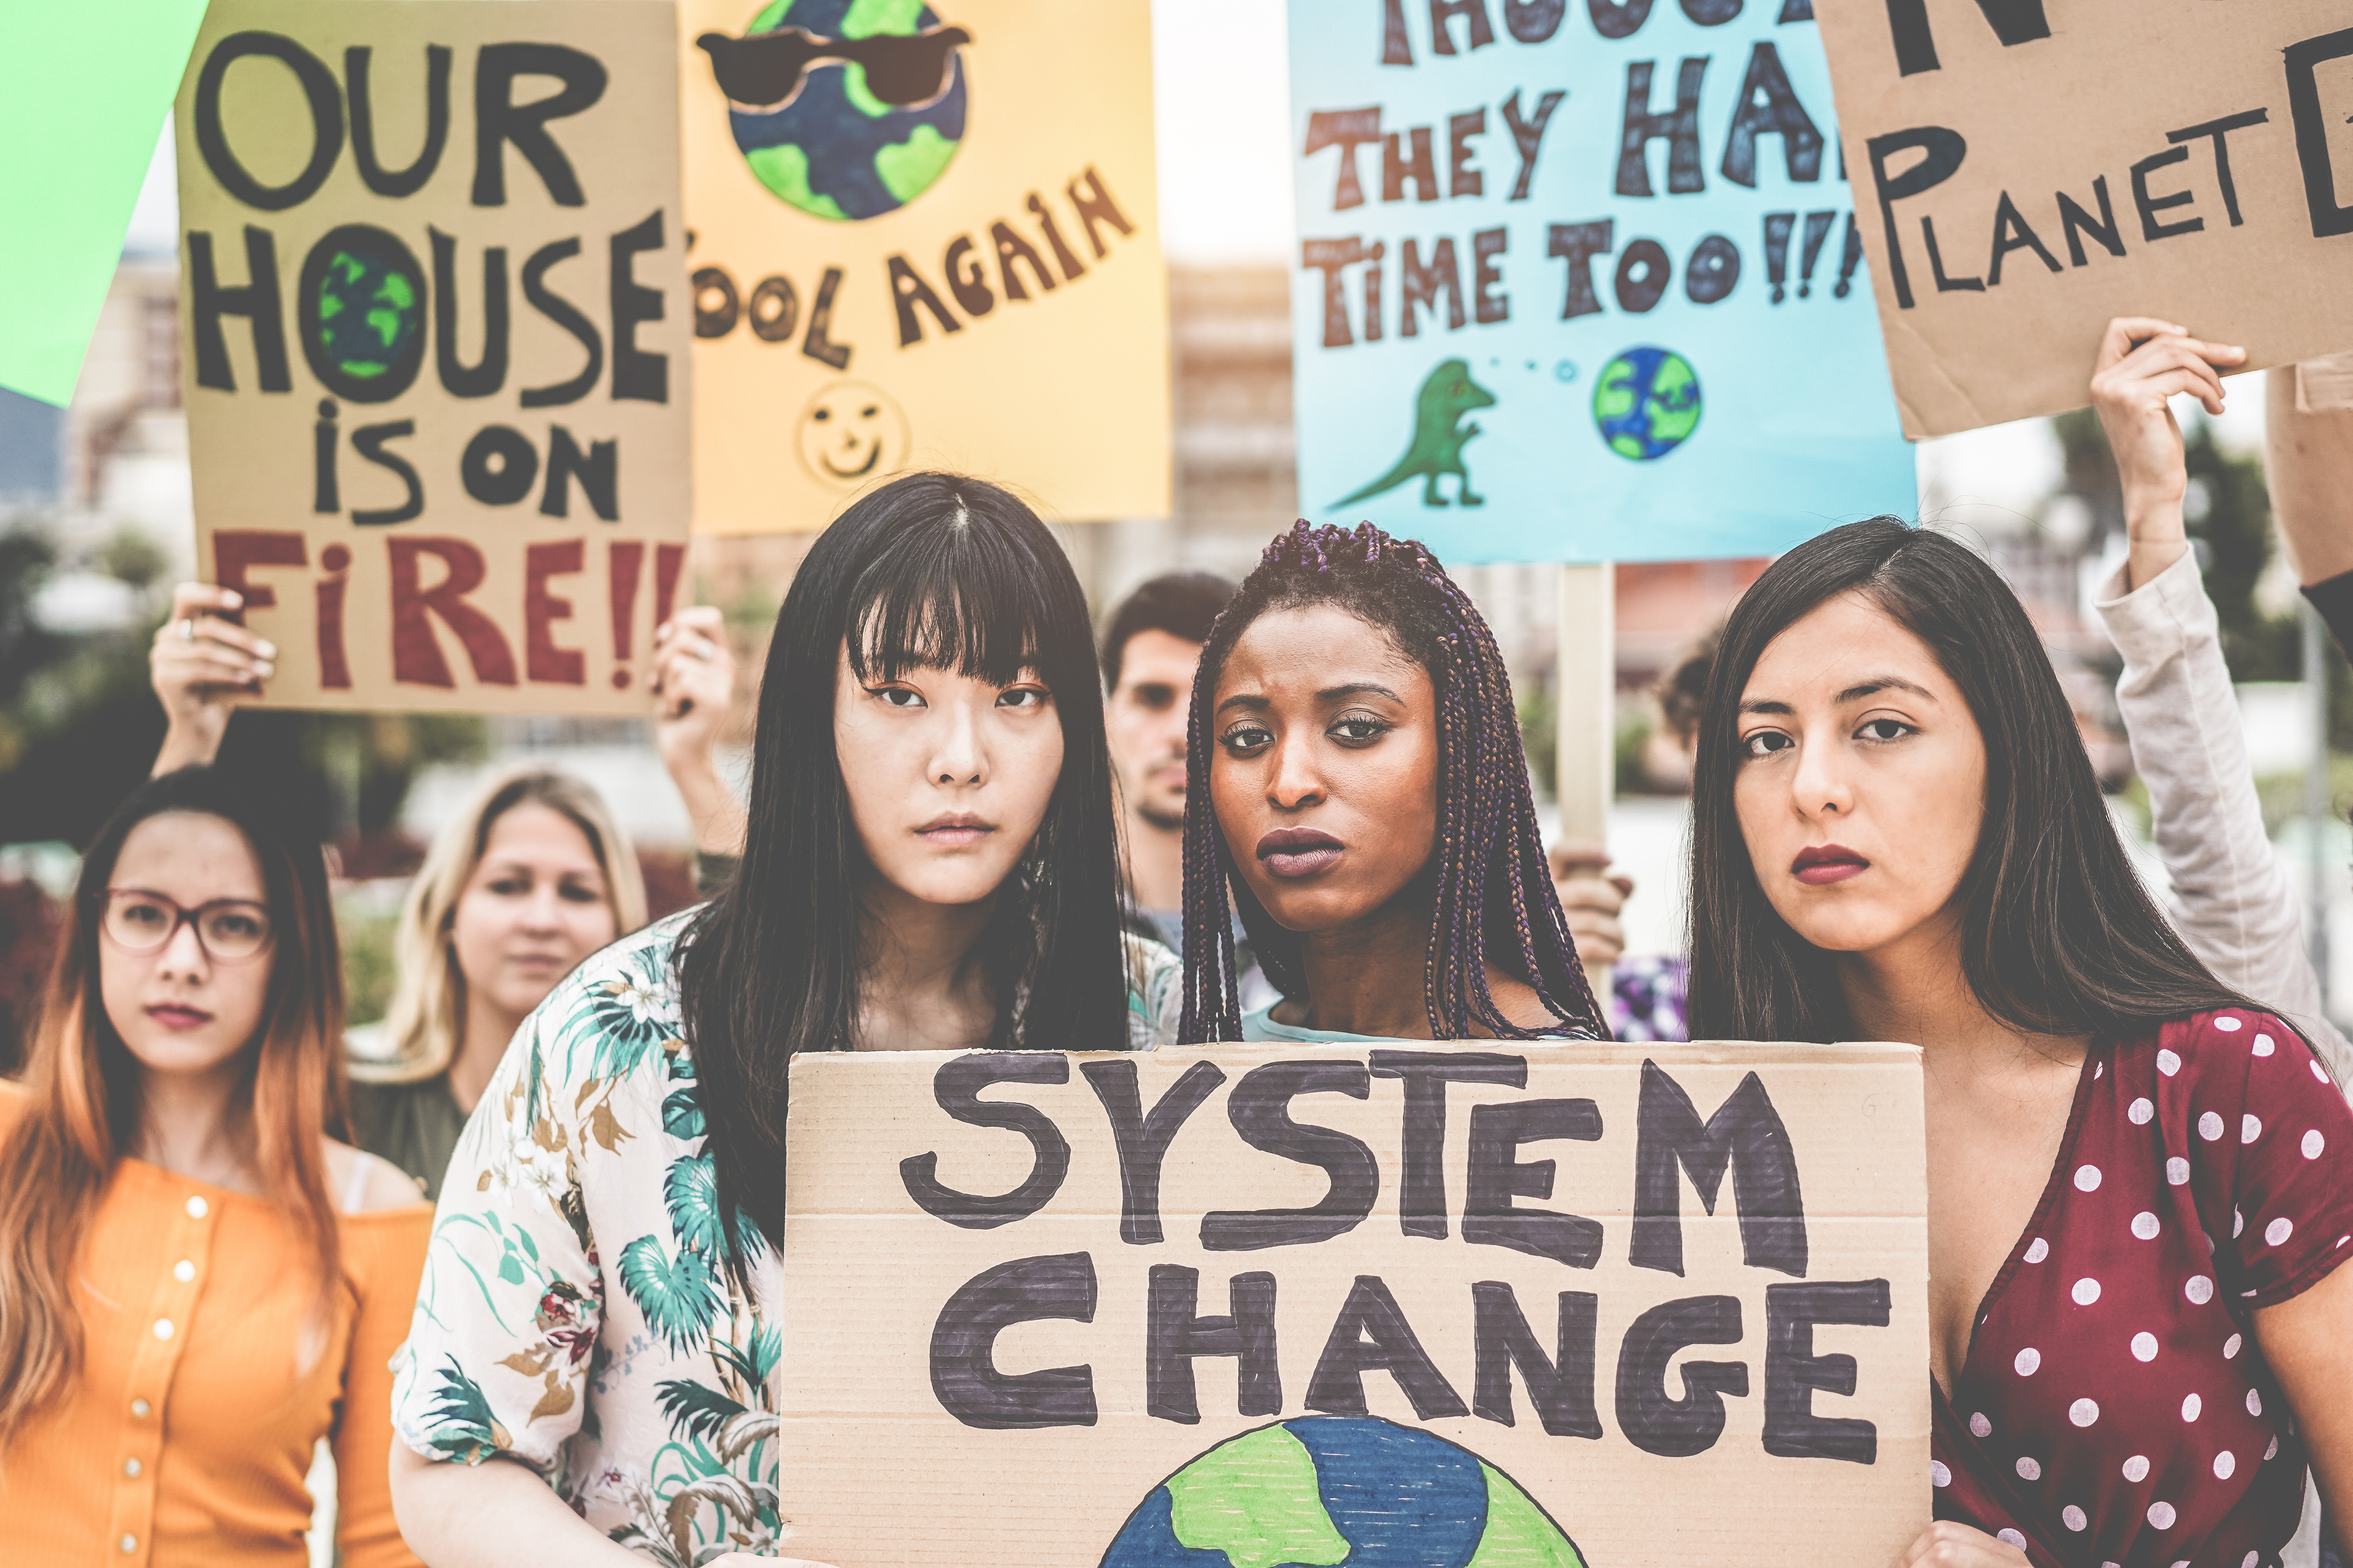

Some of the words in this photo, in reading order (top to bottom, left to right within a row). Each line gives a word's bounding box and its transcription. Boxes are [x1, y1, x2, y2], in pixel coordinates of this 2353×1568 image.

[194, 30, 608, 212] OUR
[1303, 89, 1568, 211] THEY
[1614, 41, 1848, 198] HA
[1866, 107, 2269, 309] PLANET
[186, 209, 668, 408] HOUSE
[685, 230, 851, 370] OOL
[460, 424, 619, 522] ON
[899, 1050, 1809, 1278] SYSTEM
[929, 1251, 1892, 1465] CHANGE
